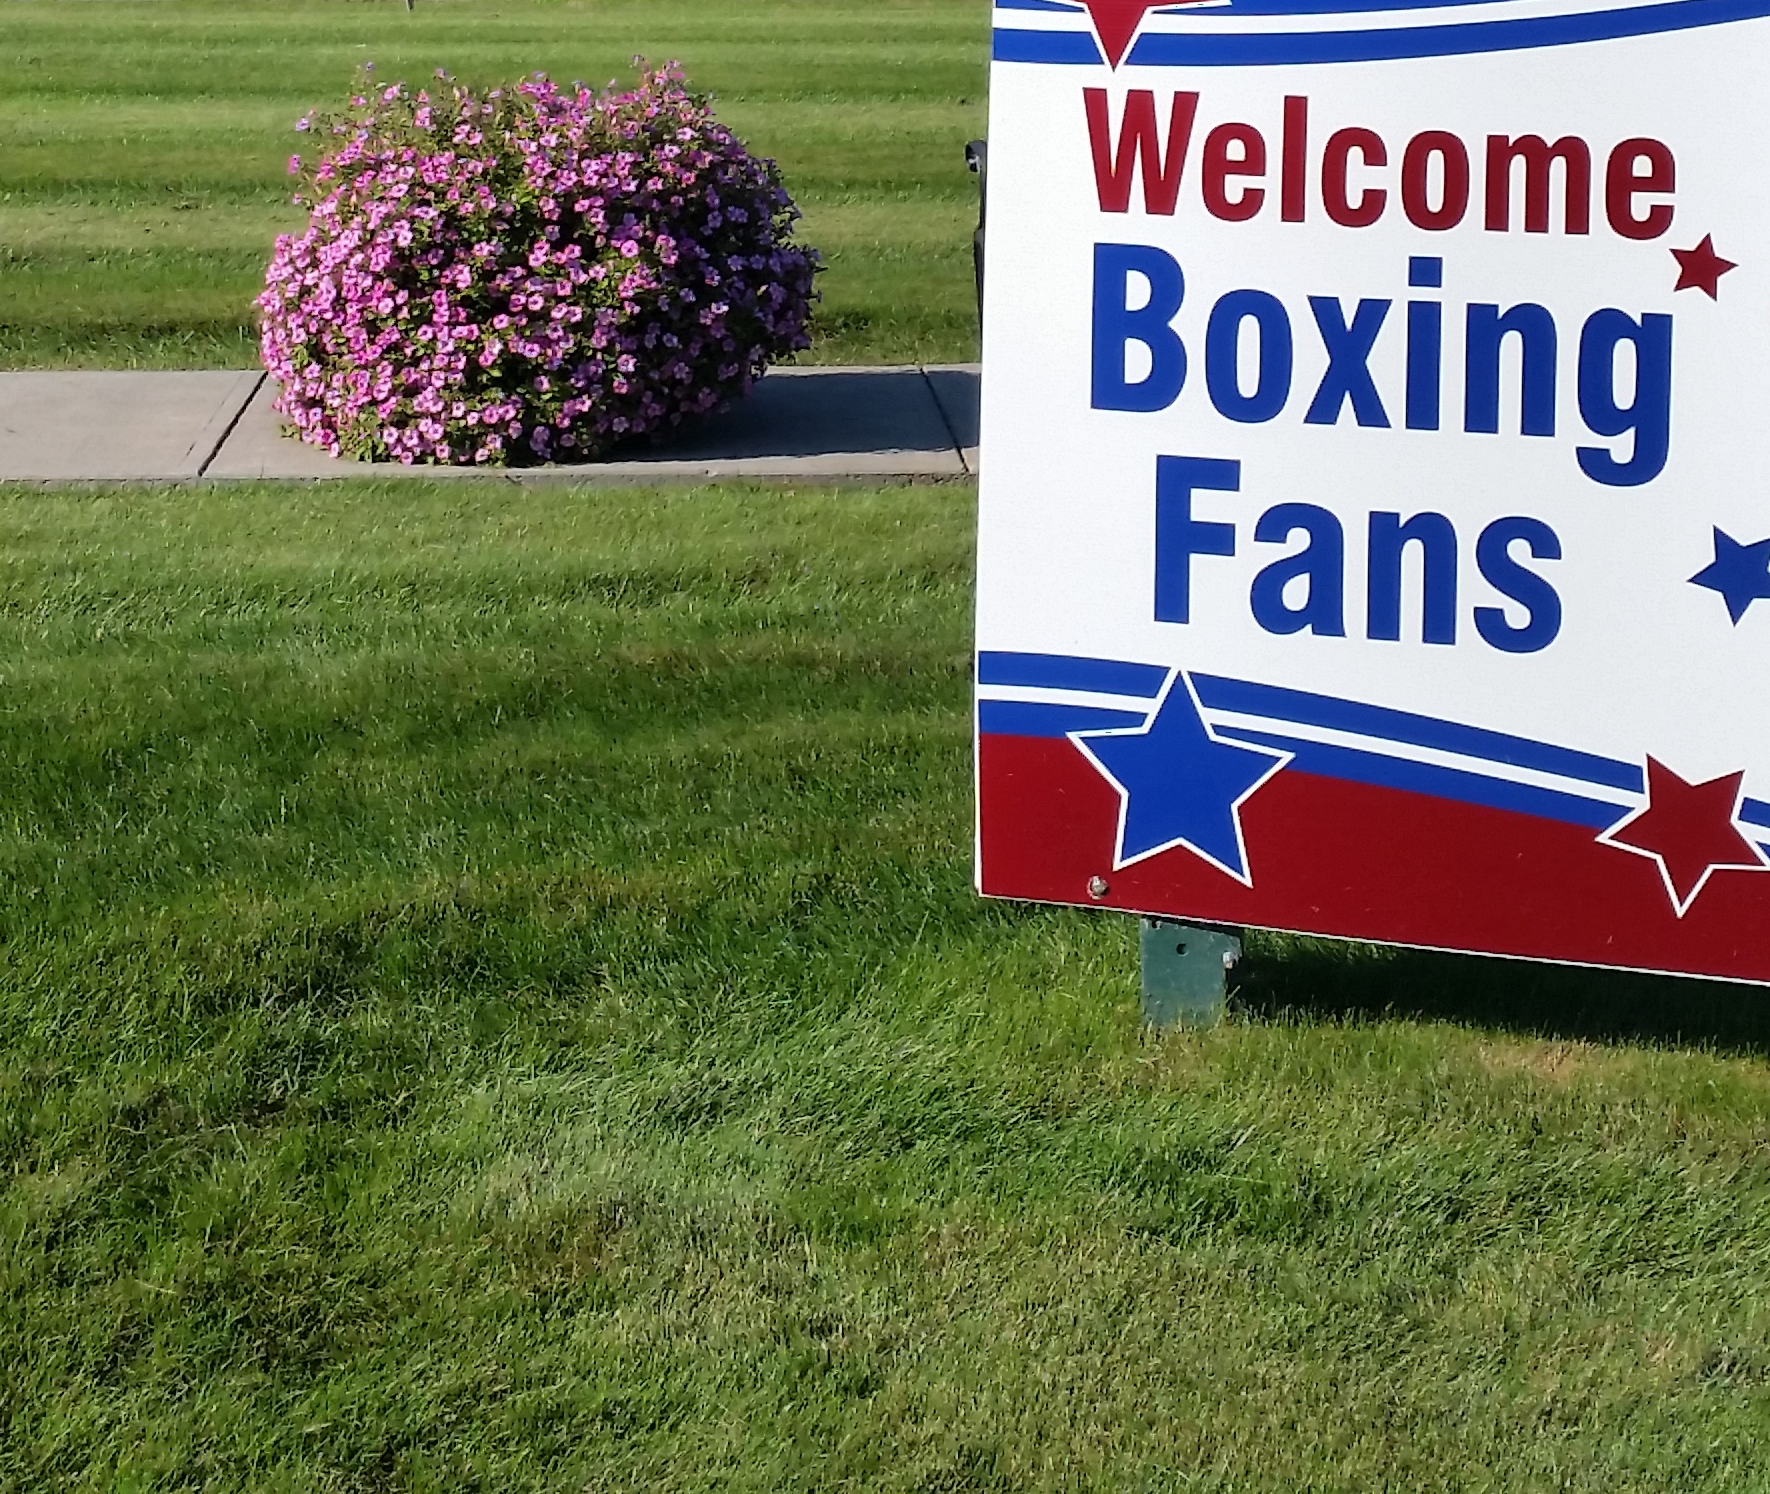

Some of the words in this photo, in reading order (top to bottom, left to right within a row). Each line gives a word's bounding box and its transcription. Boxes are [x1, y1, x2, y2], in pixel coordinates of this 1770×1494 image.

[1082, 86, 1676, 241] Welcome
[1090, 242, 1674, 487] Boxing
[1153, 454, 1562, 654] Fans
